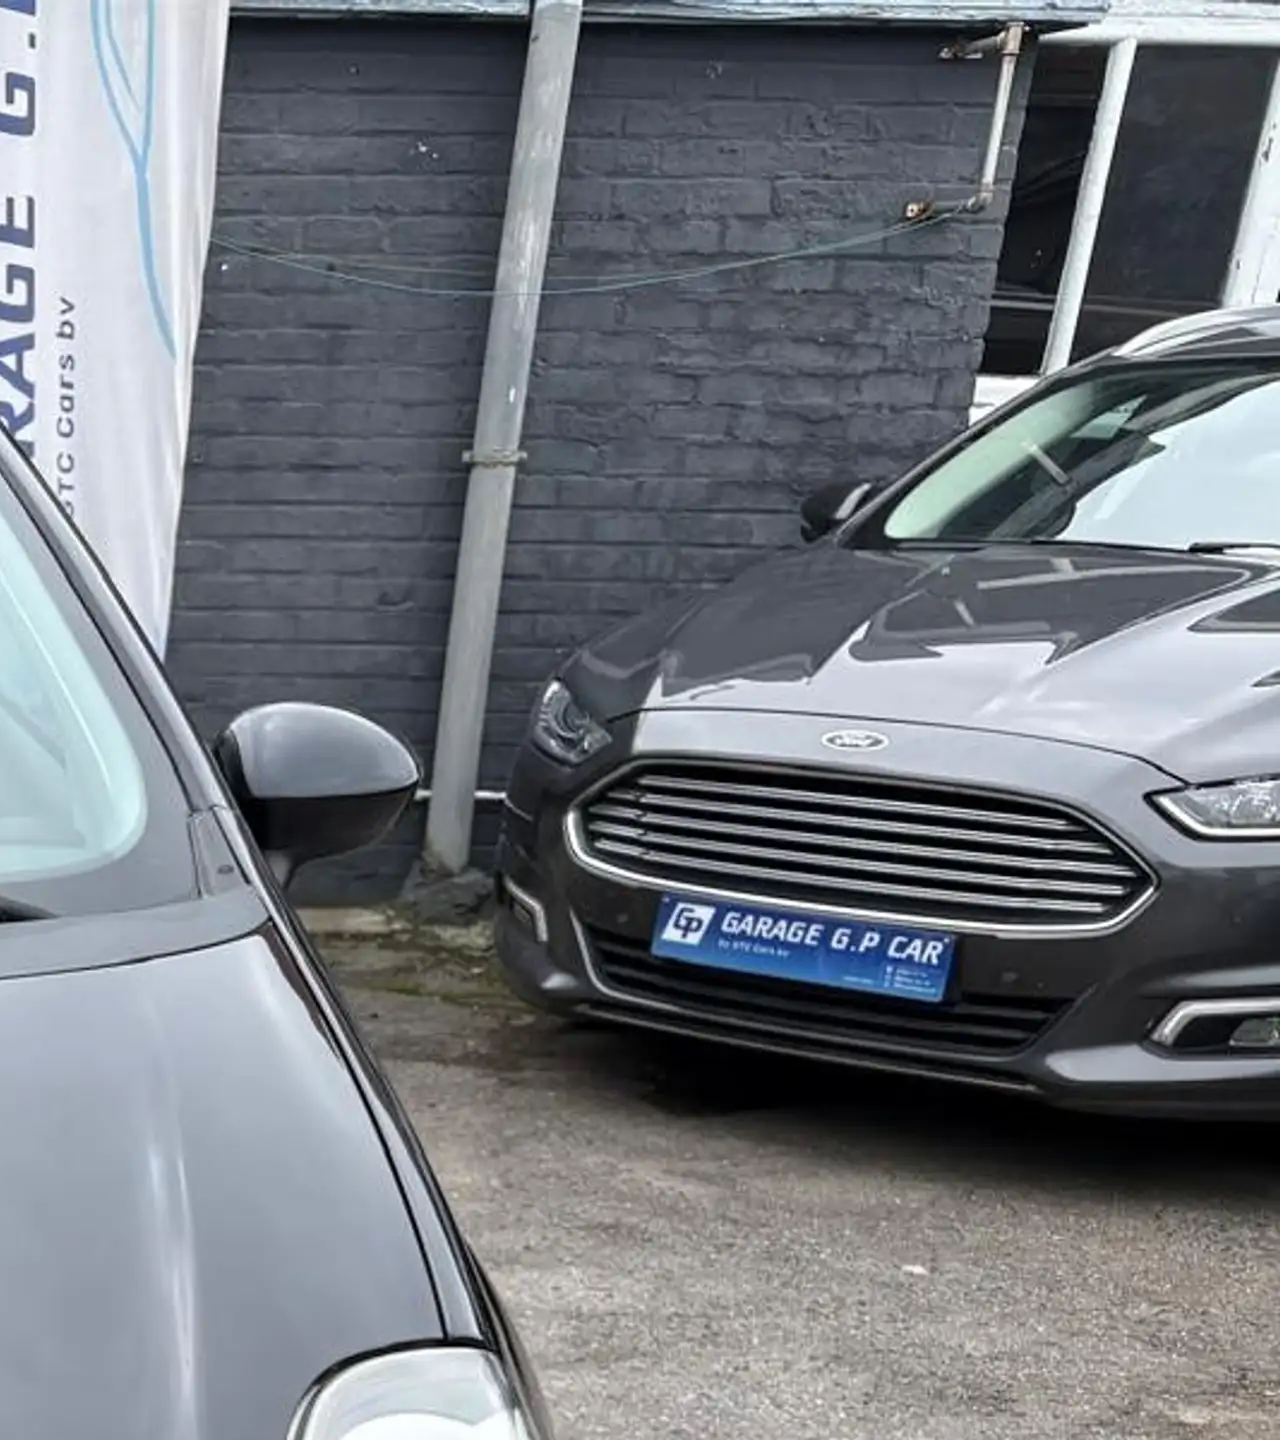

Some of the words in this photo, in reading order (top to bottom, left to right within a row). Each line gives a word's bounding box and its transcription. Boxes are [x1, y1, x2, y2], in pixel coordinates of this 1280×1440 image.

[56, 297, 75, 340] bv
[56, 354, 75, 438] Cars
[720, 911, 825, 947] GARAGE
[830, 928, 881, 953] G.P
[886, 935, 945, 966] CAR
